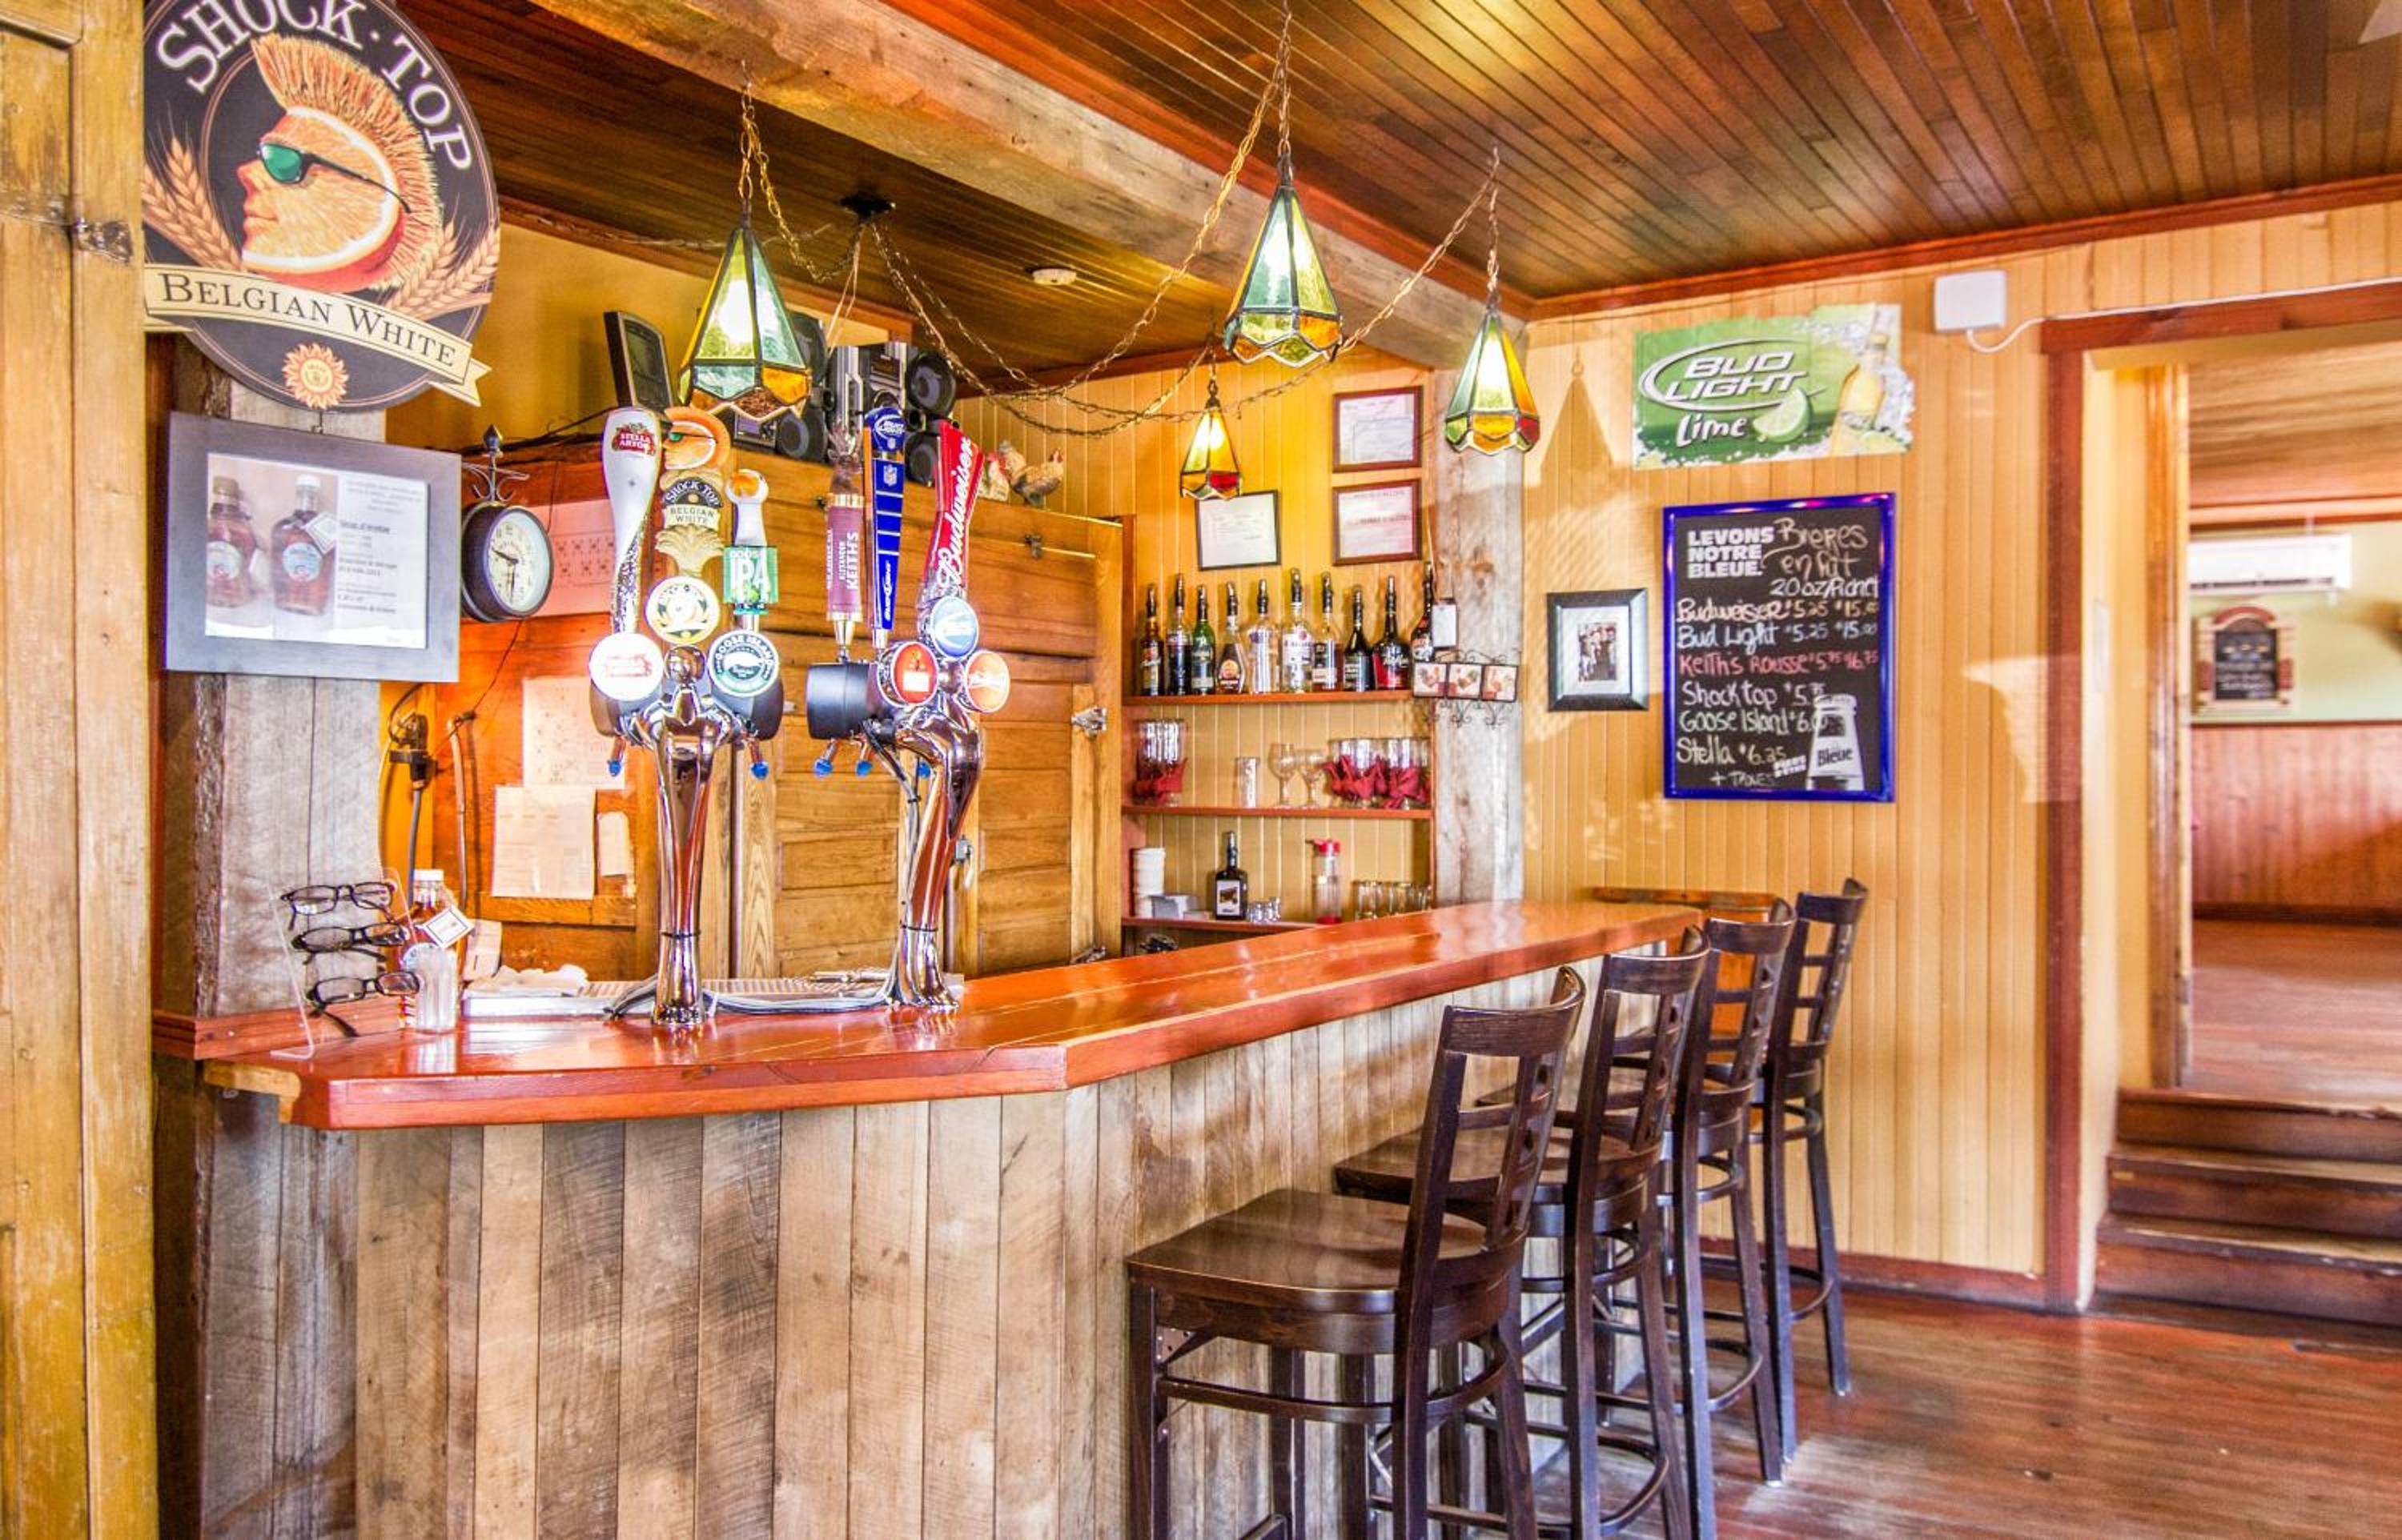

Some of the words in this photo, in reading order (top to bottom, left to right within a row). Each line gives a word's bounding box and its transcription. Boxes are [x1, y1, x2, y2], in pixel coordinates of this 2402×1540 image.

[156, 0, 368, 94] SHOCK
[380, 34, 474, 170] TOP
[1684, 350, 1794, 380] BUD
[1665, 370, 1807, 403] LIGHT
[620, 432, 651, 443] STELLA
[665, 479, 699, 502] SHOCK
[701, 483, 720, 505] TOP
[670, 507, 714, 518] BELGIAN
[937, 437, 973, 588] Budweiser
[1687, 526, 1774, 546] LEVONS
[1687, 544, 1762, 562] NOTRE
[1781, 554, 1812, 580] en
[1687, 560, 1764, 579] BLEUE.
[715, 635, 745, 659] GOOSE
[745, 635, 774, 665] ISLAND
[1677, 624, 1717, 648] Bud
[1724, 620, 1781, 655] Light
[1681, 680, 1741, 709] Shock
[1741, 681, 1777, 712] top
[1679, 708, 1737, 733] Goose
[1741, 706, 1789, 736] Island
[1676, 734, 1736, 766] Stella
[1817, 748, 1854, 767] Bleue
